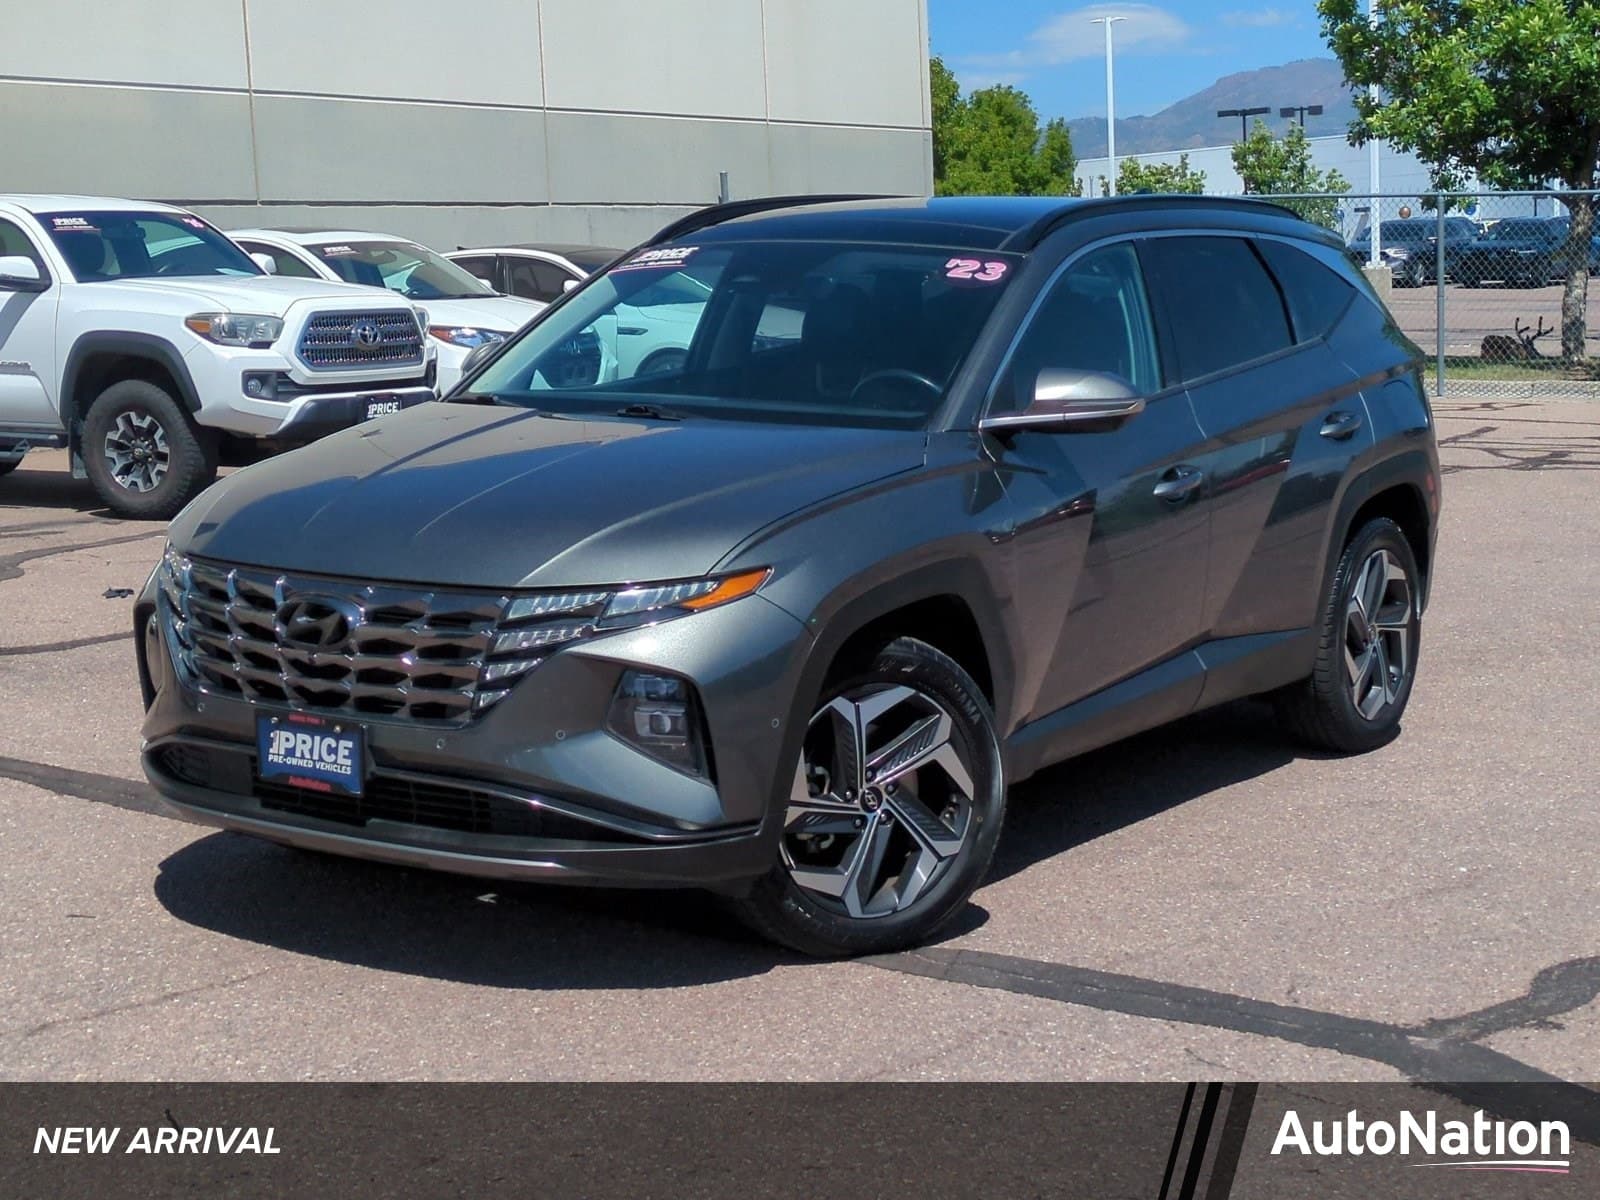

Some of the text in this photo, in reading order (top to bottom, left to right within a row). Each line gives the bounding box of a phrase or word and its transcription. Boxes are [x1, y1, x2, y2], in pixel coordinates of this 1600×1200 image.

[944, 258, 1007, 281] '23
[268, 754, 352, 775] PRE-OWNED VEHICLES
